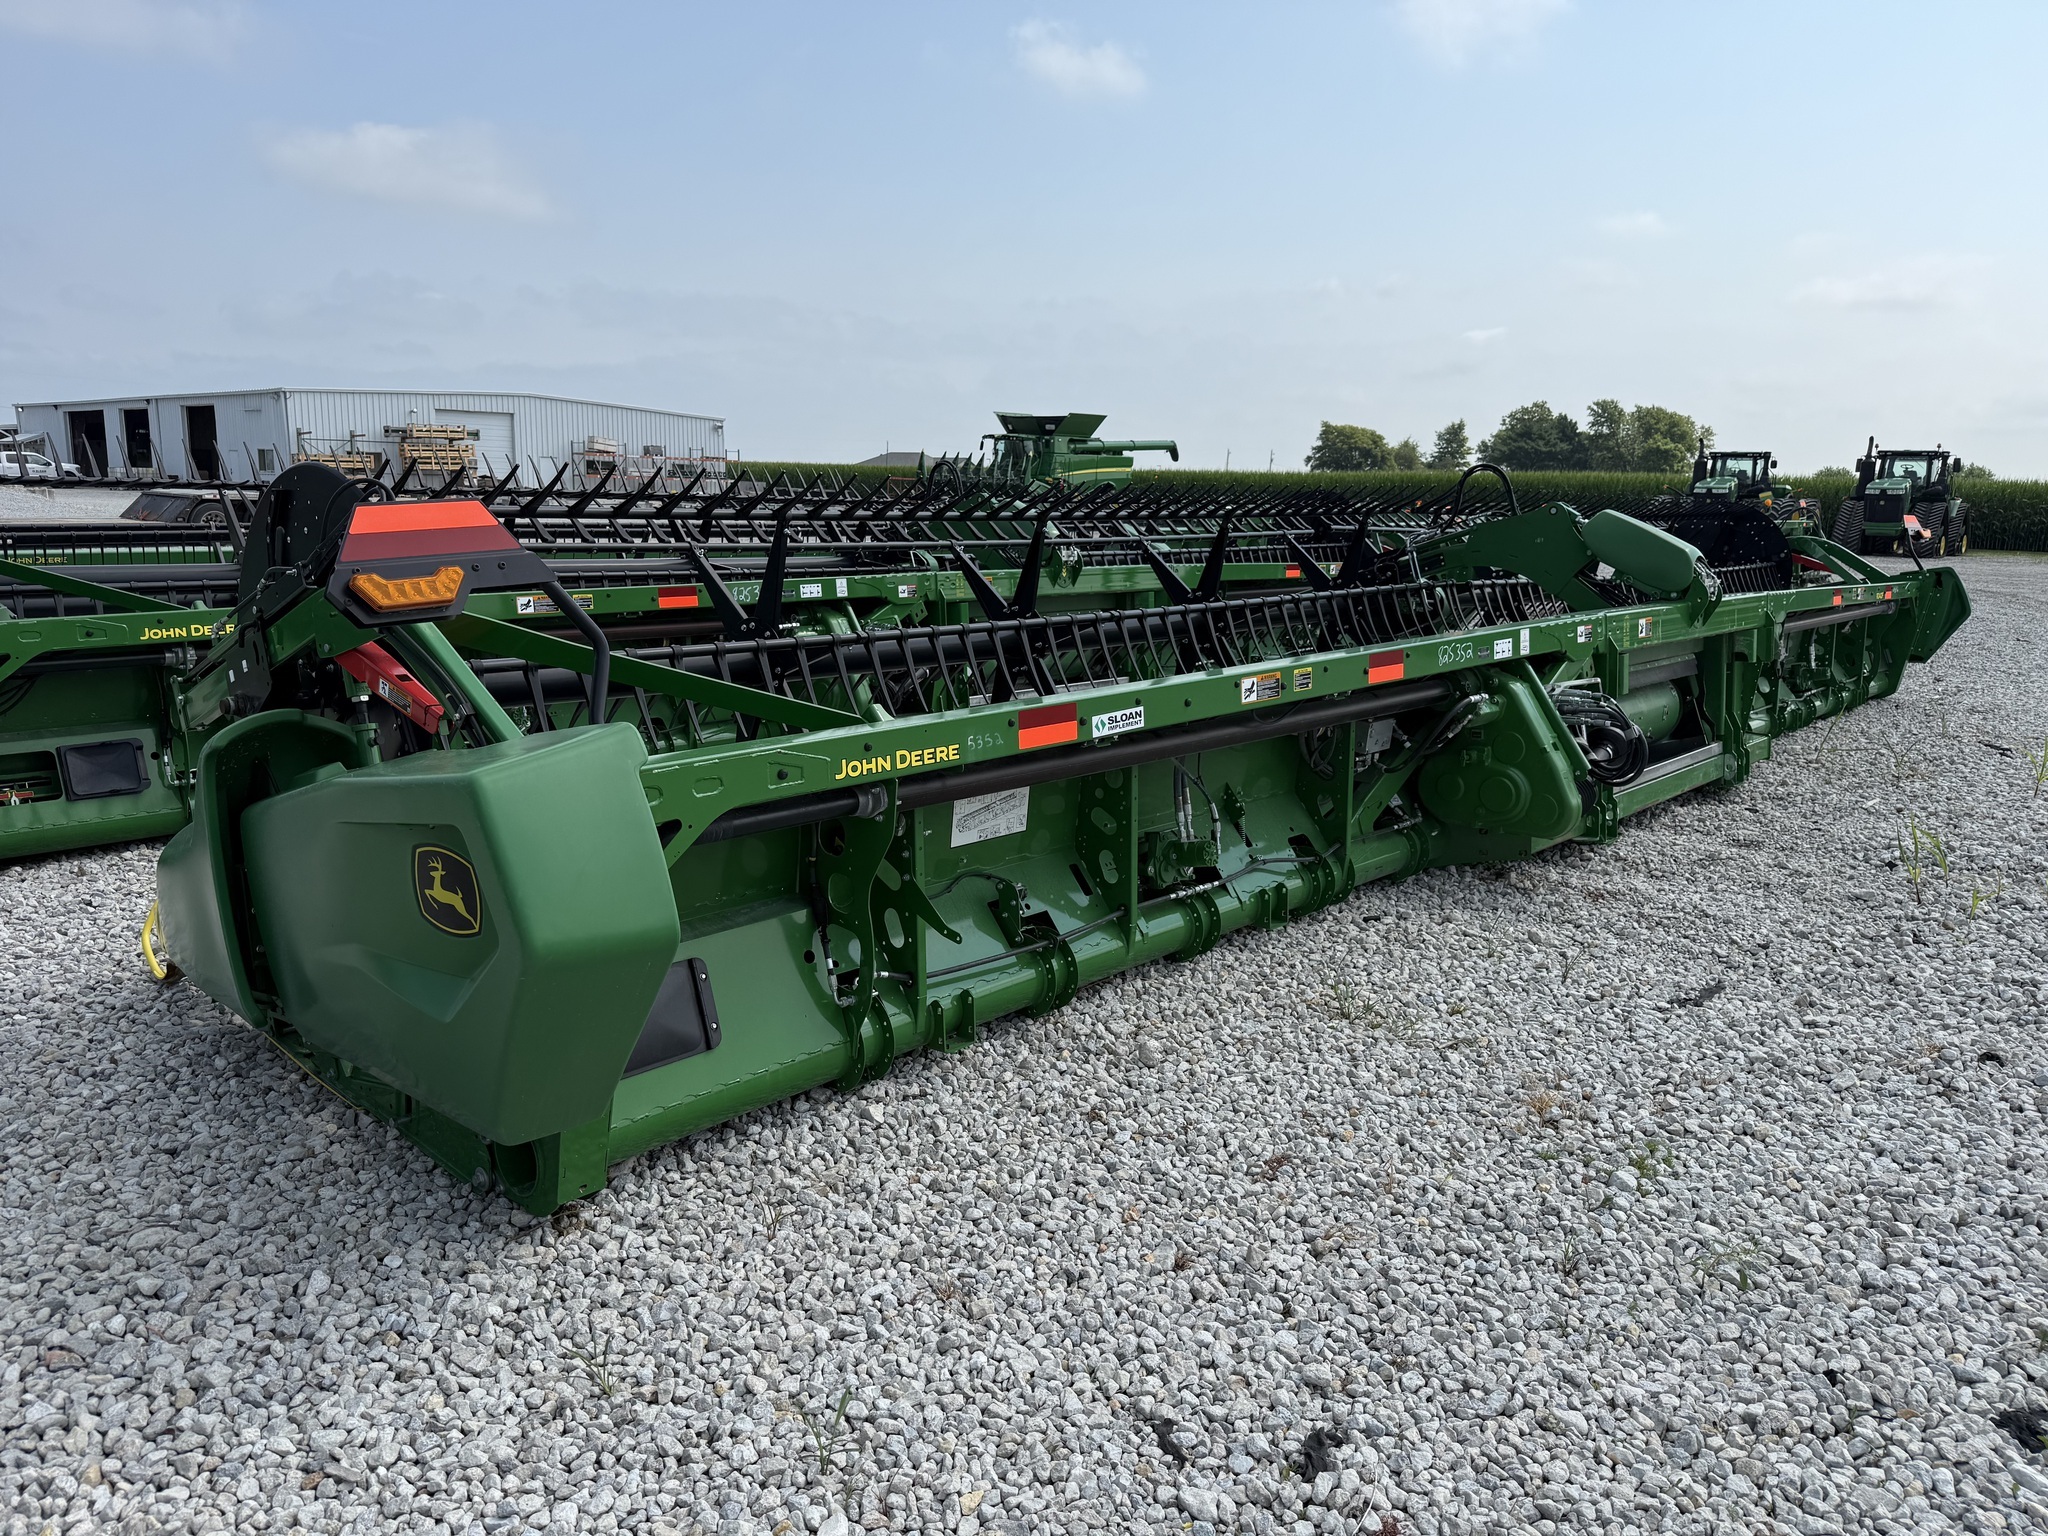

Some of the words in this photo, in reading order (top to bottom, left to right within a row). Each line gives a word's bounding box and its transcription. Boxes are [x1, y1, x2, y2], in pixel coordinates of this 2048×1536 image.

[140, 627, 188, 640] JOHN
[1107, 710, 1142, 725] SLOAN
[1108, 719, 1142, 731] IMPLEMENT
[967, 732, 1004, 750] 5352
[835, 755, 891, 780] JOHN
[895, 744, 960, 769] DEERE
